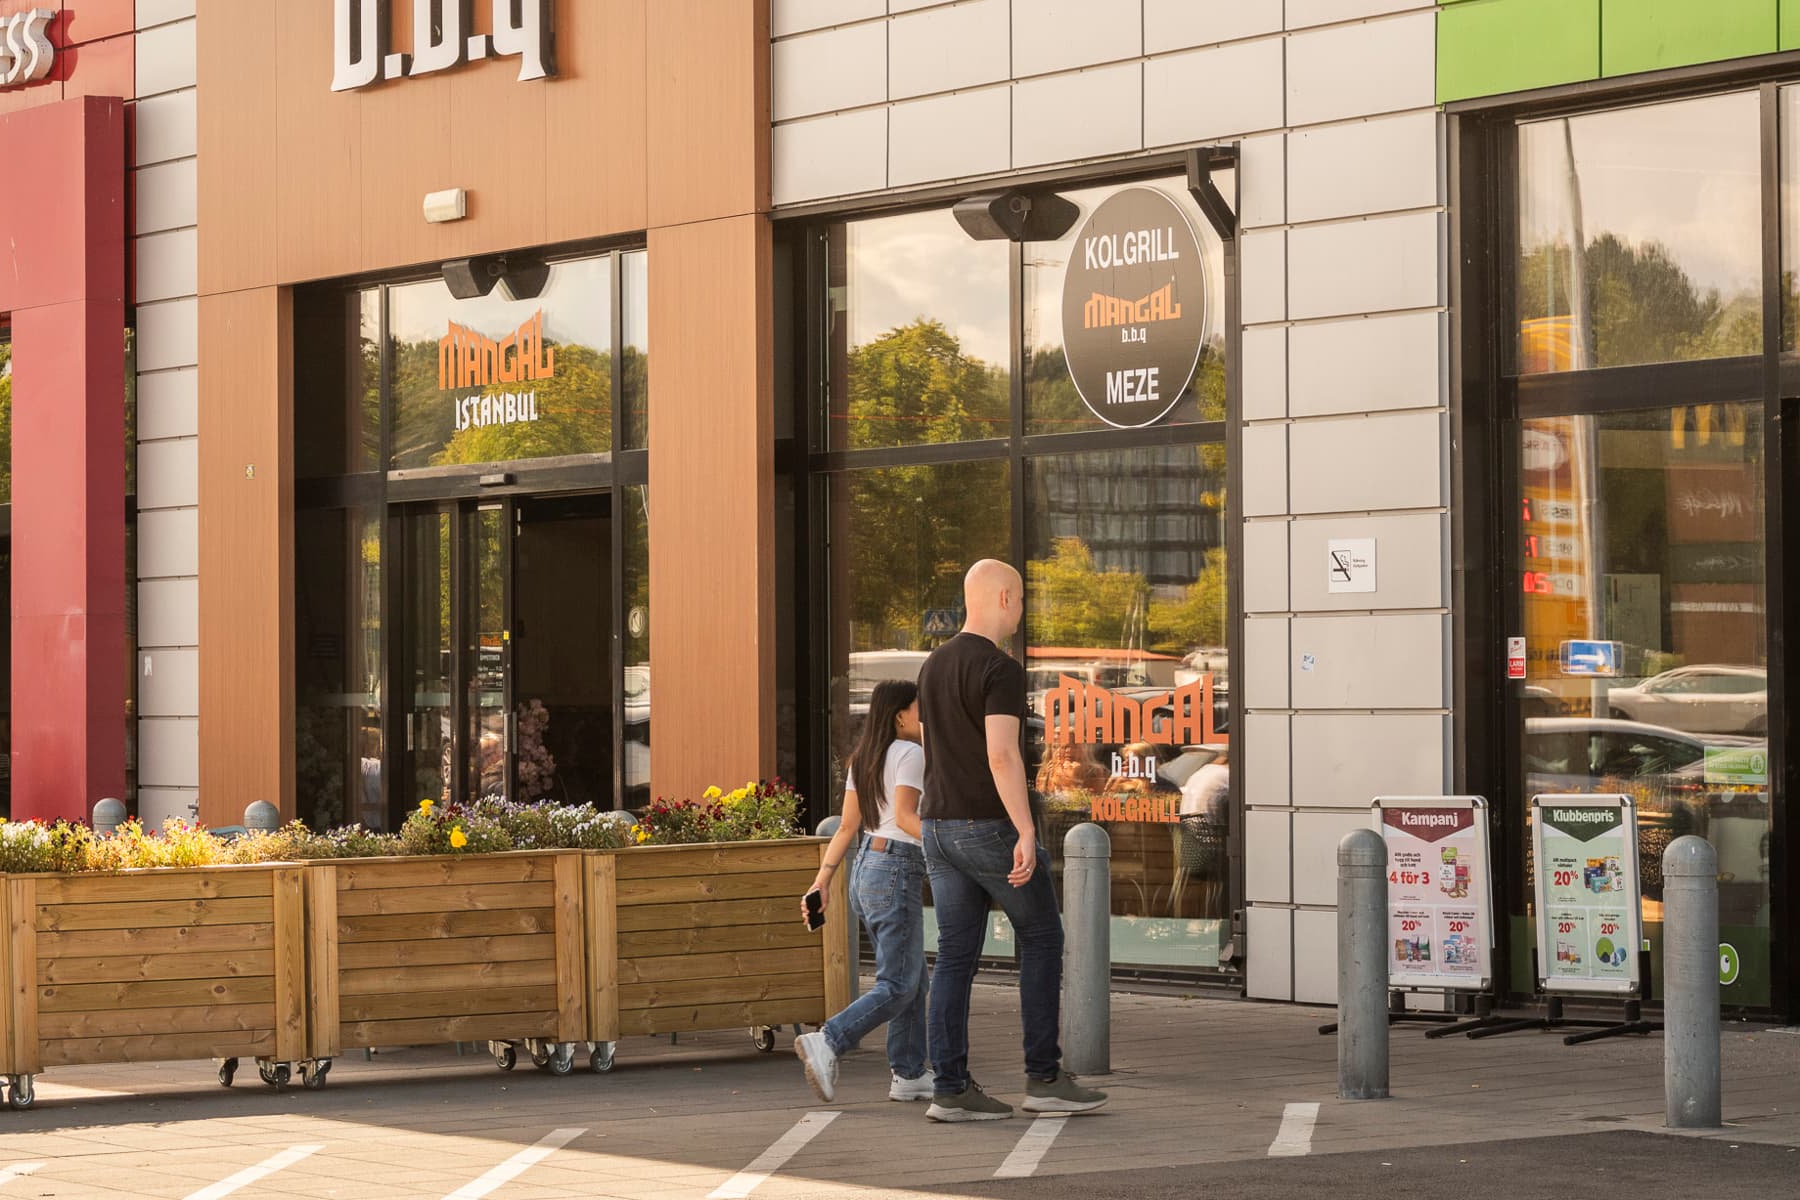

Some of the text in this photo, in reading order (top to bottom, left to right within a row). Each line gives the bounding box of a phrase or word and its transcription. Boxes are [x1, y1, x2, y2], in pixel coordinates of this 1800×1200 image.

[1084, 226, 1180, 270] KOLGRILL
[1084, 281, 1182, 329] MANGAL
[438, 306, 554, 391] MANGAL
[1121, 327, 1147, 344] b.b.q
[1106, 367, 1160, 405] MEZE
[455, 389, 538, 432] ISTANBUL
[1045, 672, 1230, 745] MANGAL
[1111, 751, 1157, 784] b.b.q
[1091, 798, 1181, 824] KOLGRILL
[1401, 811, 1459, 828] Kampanj
[1552, 809, 1615, 824] Klubbenpris
[1389, 871, 1398, 884] 4
[1400, 871, 1419, 884] för
[1421, 871, 1430, 885] 3
[1554, 870, 1579, 886] 20%
